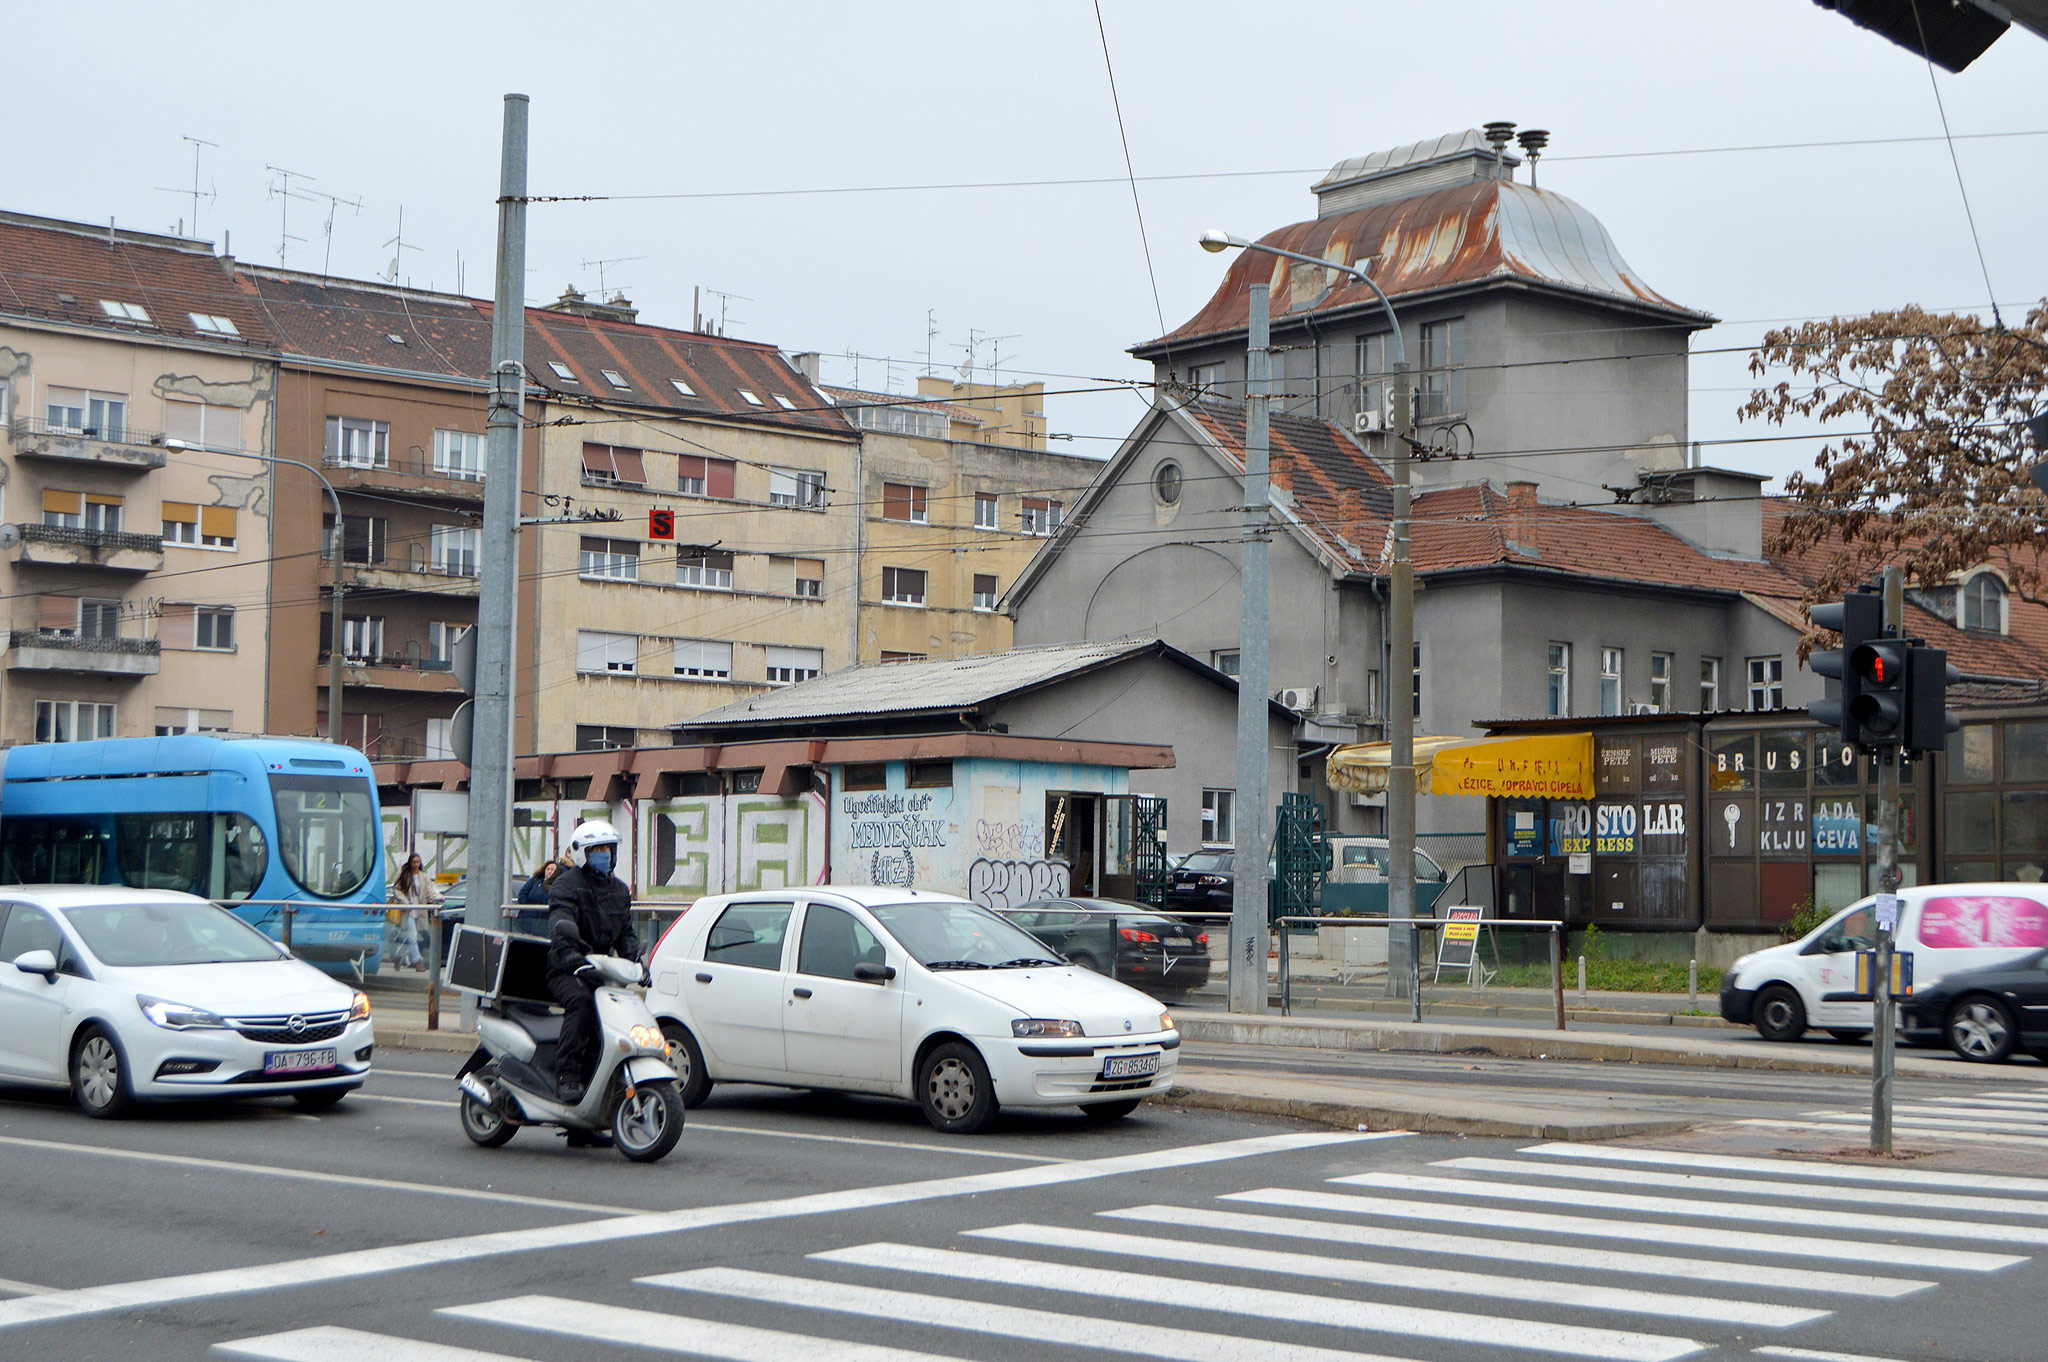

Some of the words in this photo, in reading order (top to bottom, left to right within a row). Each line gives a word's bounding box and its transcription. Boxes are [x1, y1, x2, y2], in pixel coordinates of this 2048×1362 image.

[653, 513, 671, 536] S
[1650, 745, 1678, 756] MUŠKE
[1603, 756, 1629, 766] PETE
[1651, 754, 1677, 765] PETE
[1649, 773, 1657, 782] od
[1550, 781, 1584, 795] CIPELA
[316, 792, 327, 808] 2
[1563, 804, 1685, 836] POSTOLAR
[1764, 802, 1855, 822] IZRADA
[851, 814, 946, 849] MEDVEŠČAK
[1760, 826, 1858, 850] KLJUČEVA
[1563, 837, 1634, 853] EXPRESS
[1111, 1060, 1123, 1075] ZG
